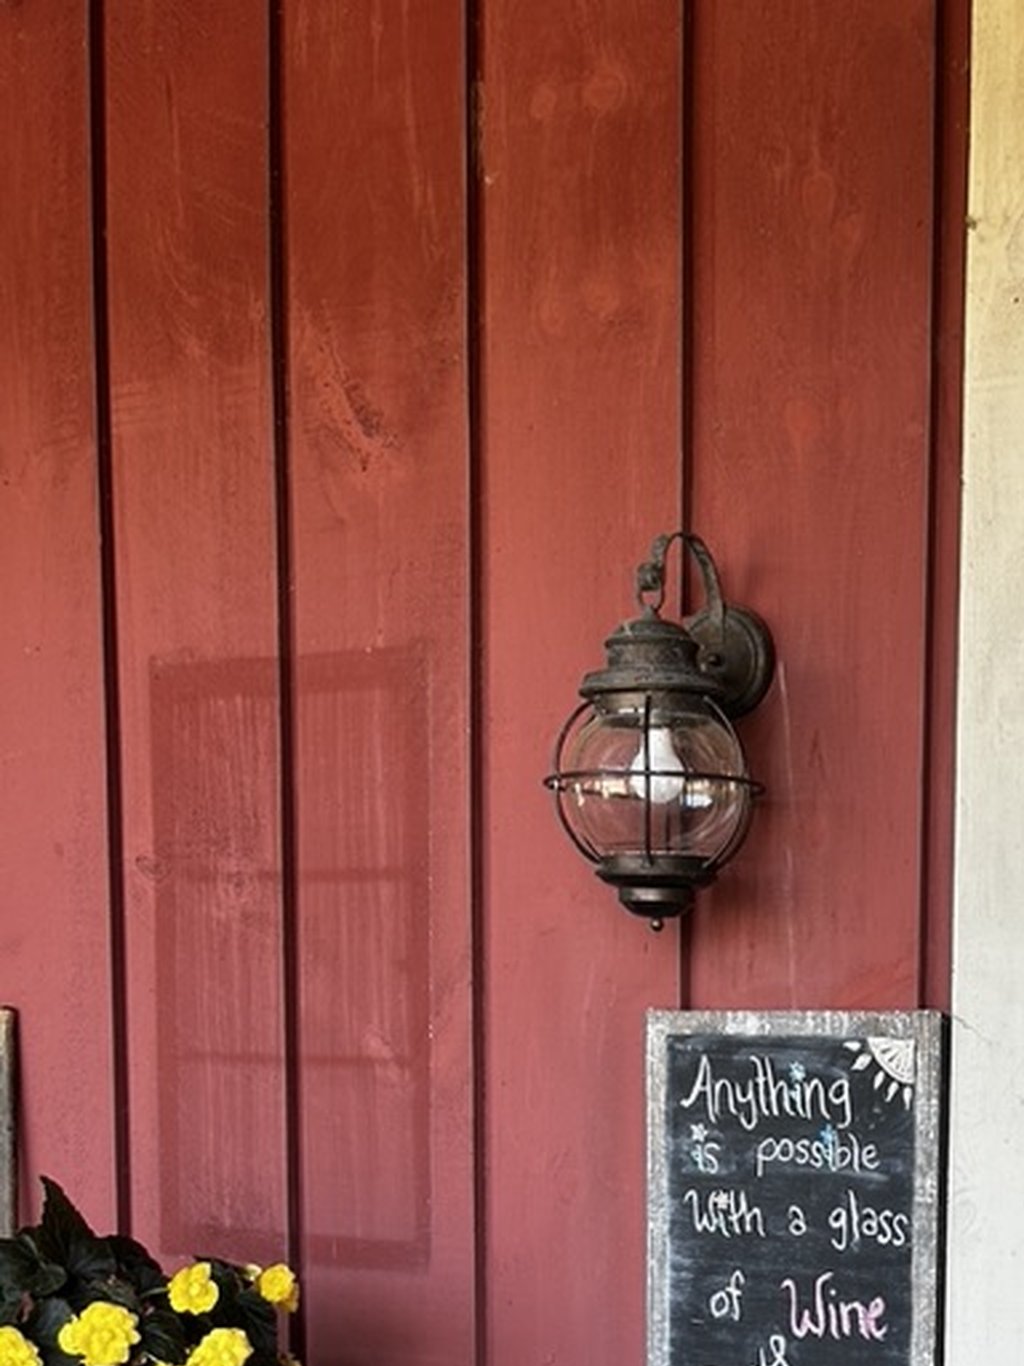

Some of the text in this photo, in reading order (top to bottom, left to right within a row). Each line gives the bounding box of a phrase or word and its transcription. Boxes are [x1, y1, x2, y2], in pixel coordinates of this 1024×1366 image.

[680, 1053, 853, 1131] Anything
[690, 1122, 881, 1178] is possible
[788, 1206, 807, 1236] a
[828, 1189, 910, 1251] glass
[709, 1270, 888, 1342] of Wine
